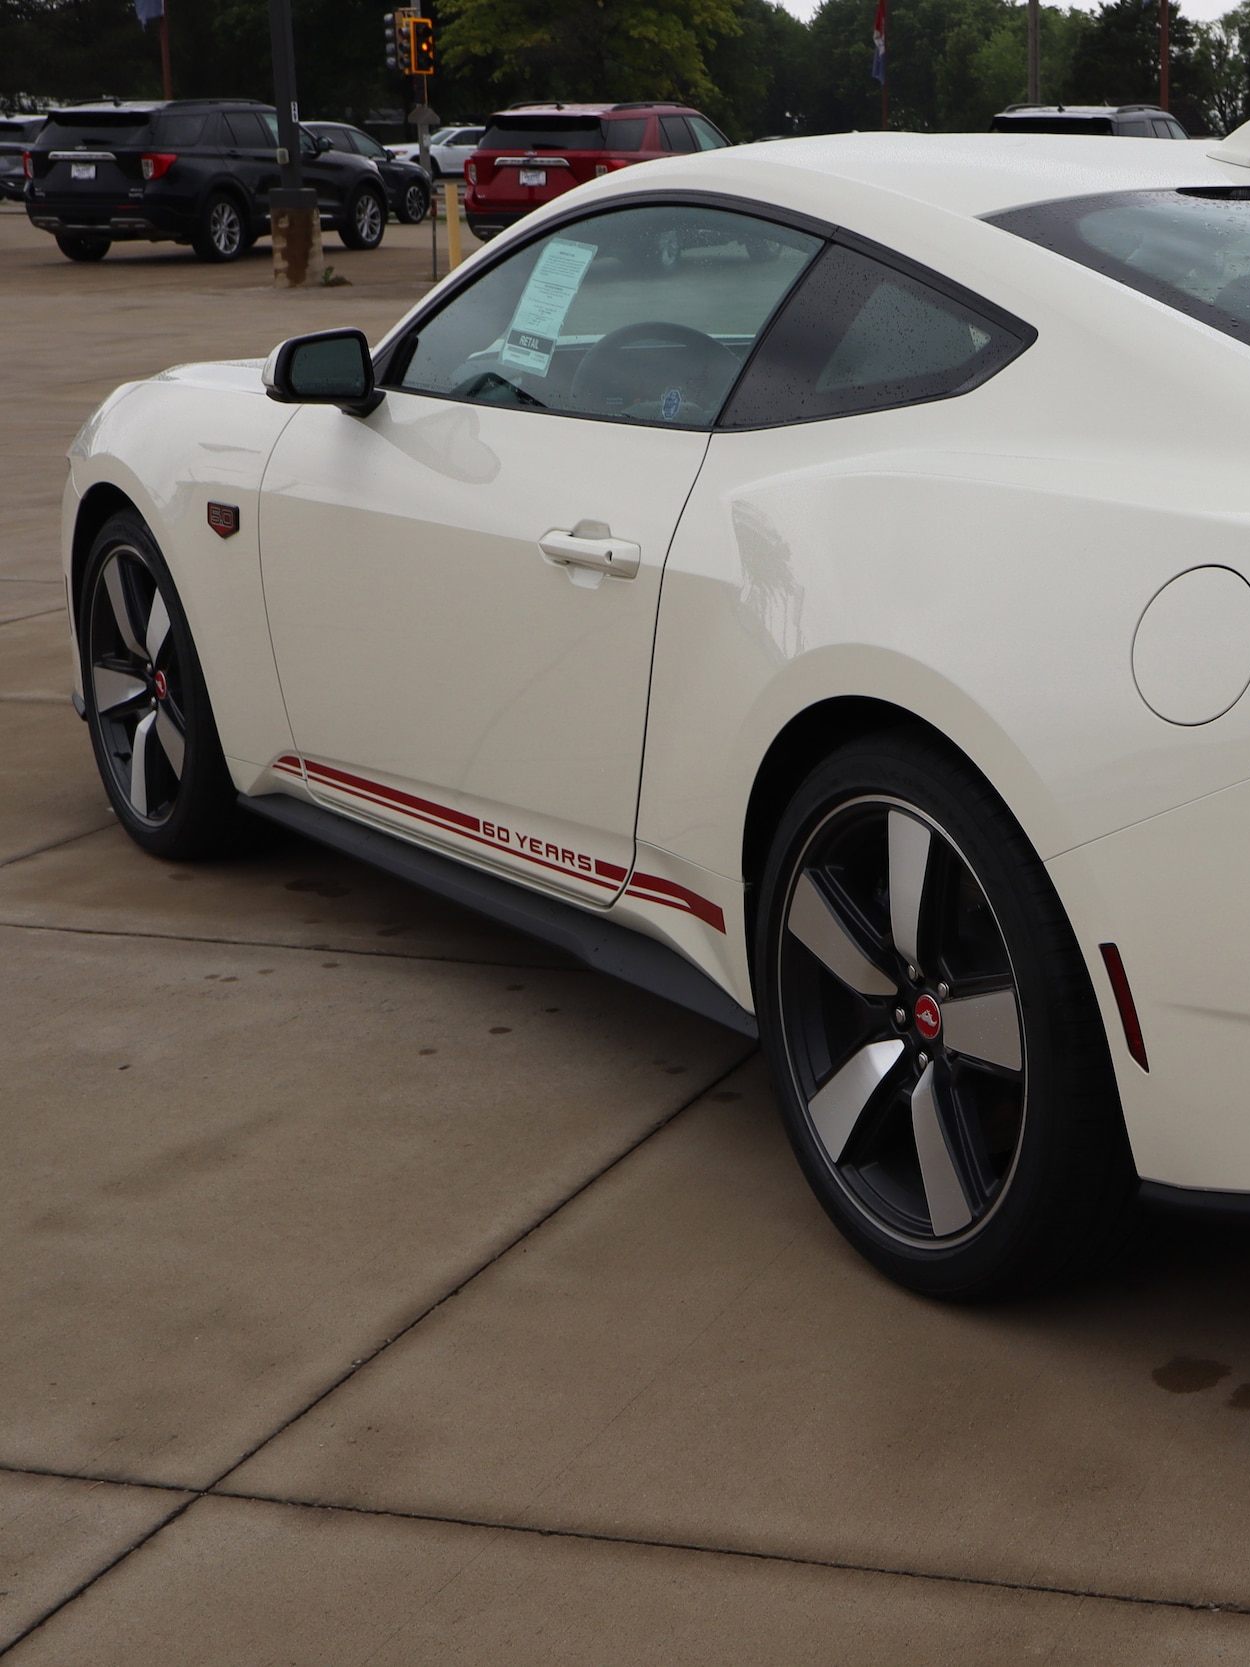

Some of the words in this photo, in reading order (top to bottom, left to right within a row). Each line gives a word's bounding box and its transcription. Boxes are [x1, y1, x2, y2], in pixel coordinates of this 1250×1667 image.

[518, 335, 539, 350] RETAIL
[211, 507, 233, 529] 5.0
[482, 820, 510, 844] 60
[515, 831, 592, 872] YEARS
